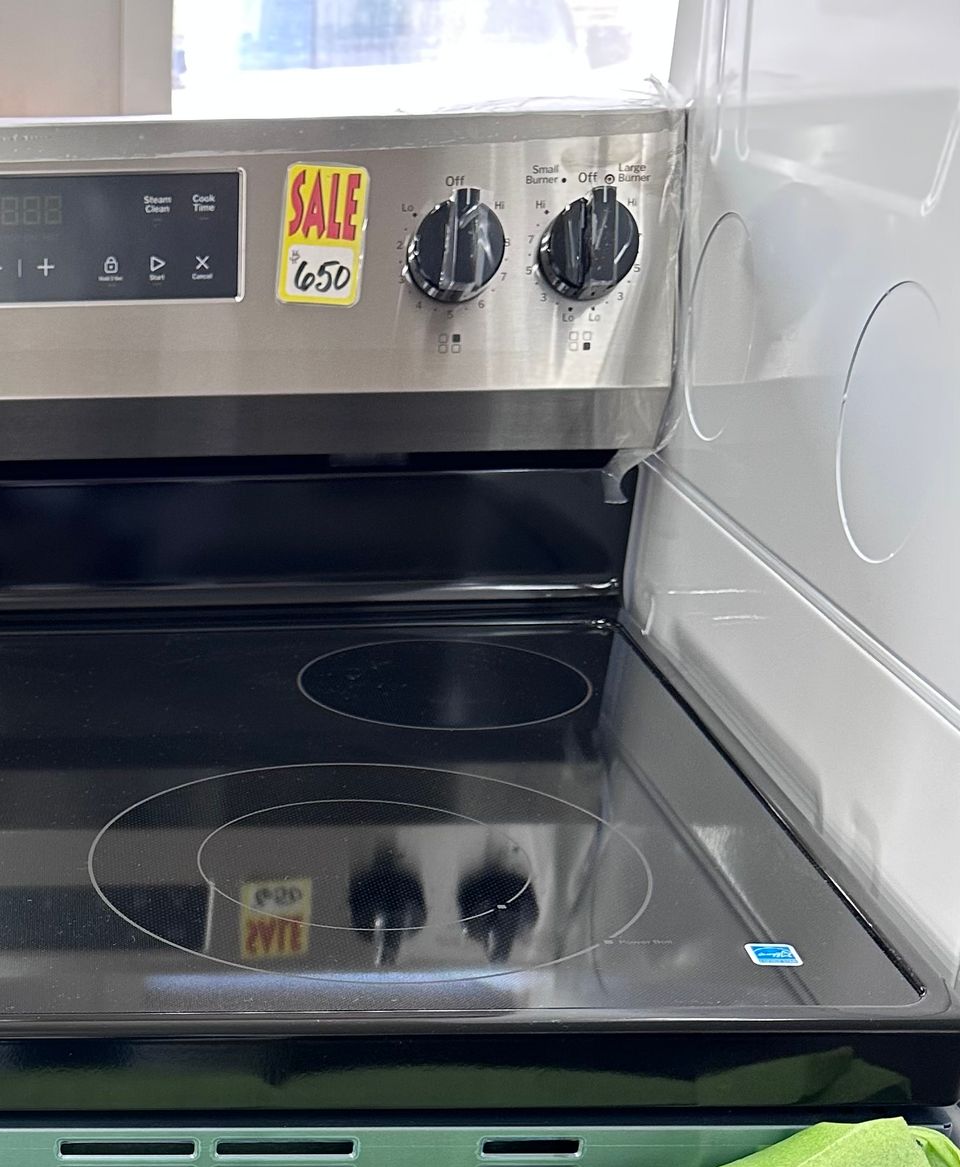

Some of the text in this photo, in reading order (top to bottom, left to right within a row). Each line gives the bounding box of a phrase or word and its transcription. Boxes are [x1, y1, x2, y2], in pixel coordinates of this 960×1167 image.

[532, 165, 559, 174] Small
[619, 164, 647, 174] Large
[445, 176, 465, 187] Off
[526, 175, 558, 185] Burner
[578, 172, 598, 183] Off
[618, 173, 651, 183] Burner
[144, 195, 172, 205] Steam
[192, 193, 216, 203] Cook
[145, 205, 170, 213] Clean
[193, 203, 216, 212] Time
[288, 169, 362, 241] SALE
[401, 204, 414, 212] Lo
[494, 201, 504, 210] Hi
[535, 200, 545, 209] Hi
